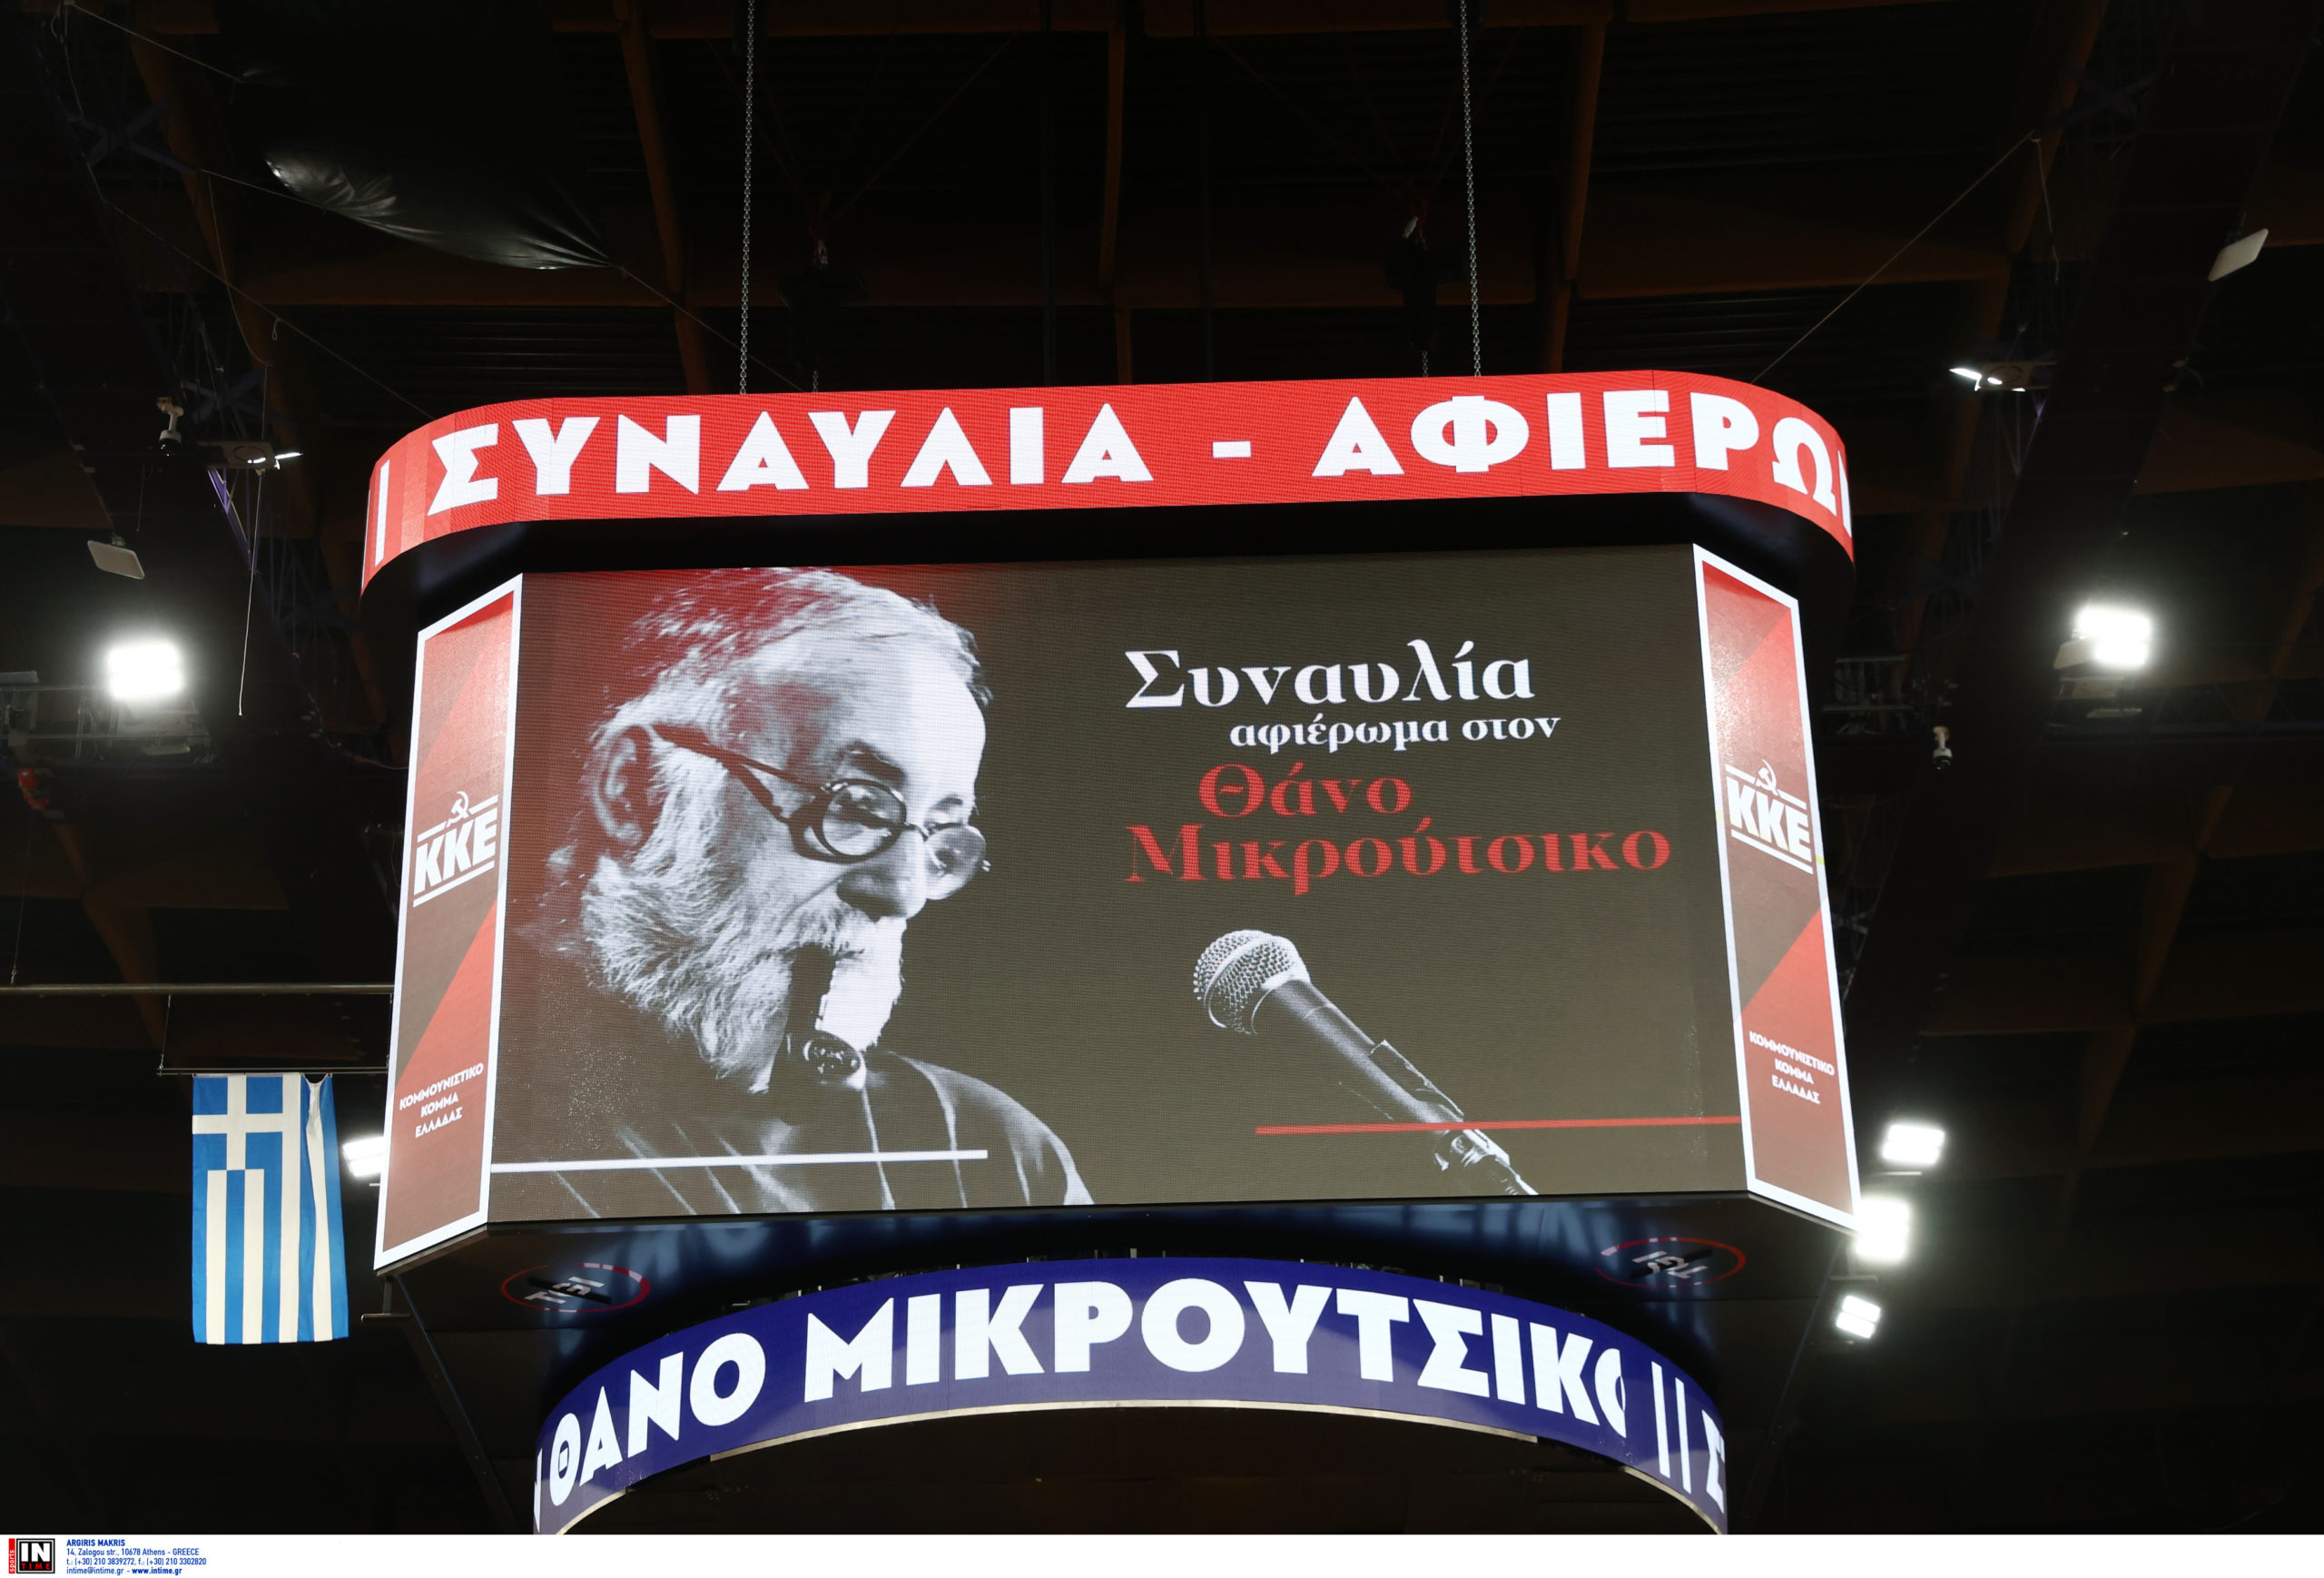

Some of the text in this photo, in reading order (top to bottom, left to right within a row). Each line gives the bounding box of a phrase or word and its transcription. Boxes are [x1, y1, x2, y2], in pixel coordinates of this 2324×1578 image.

[427, 402, 1155, 517] ΣΥΝΑΥΛΙΑ
[1212, 439, 1252, 459] -
[1311, 390, 1852, 538] ΑΦΙΕΡΩ
[1125, 638, 1535, 709] Συναυλία
[1229, 713, 1561, 754] αφιέρωμα στον
[1197, 761, 1413, 817] Θάνο
[1126, 816, 1671, 896] Μικρούτσικο
[1748, 1031, 1835, 1077] ΚΟΜΜΟΥΝΙΣΤΙΚΟ
[1774, 1059, 1814, 1086] ΚΟΜΜΑ
[399, 1062, 485, 1110] ΚΟΜΜΟΥΝΙΣΤΙΚΟ
[420, 1092, 459, 1118] ΚΟΜΜΑ
[1772, 1075, 1821, 1105] ΕΛΛΑΔΑΣ
[414, 1106, 463, 1139] ΕΛΛΑΔΑΣ
[549, 1333, 766, 1507] ΘΑΝΟ
